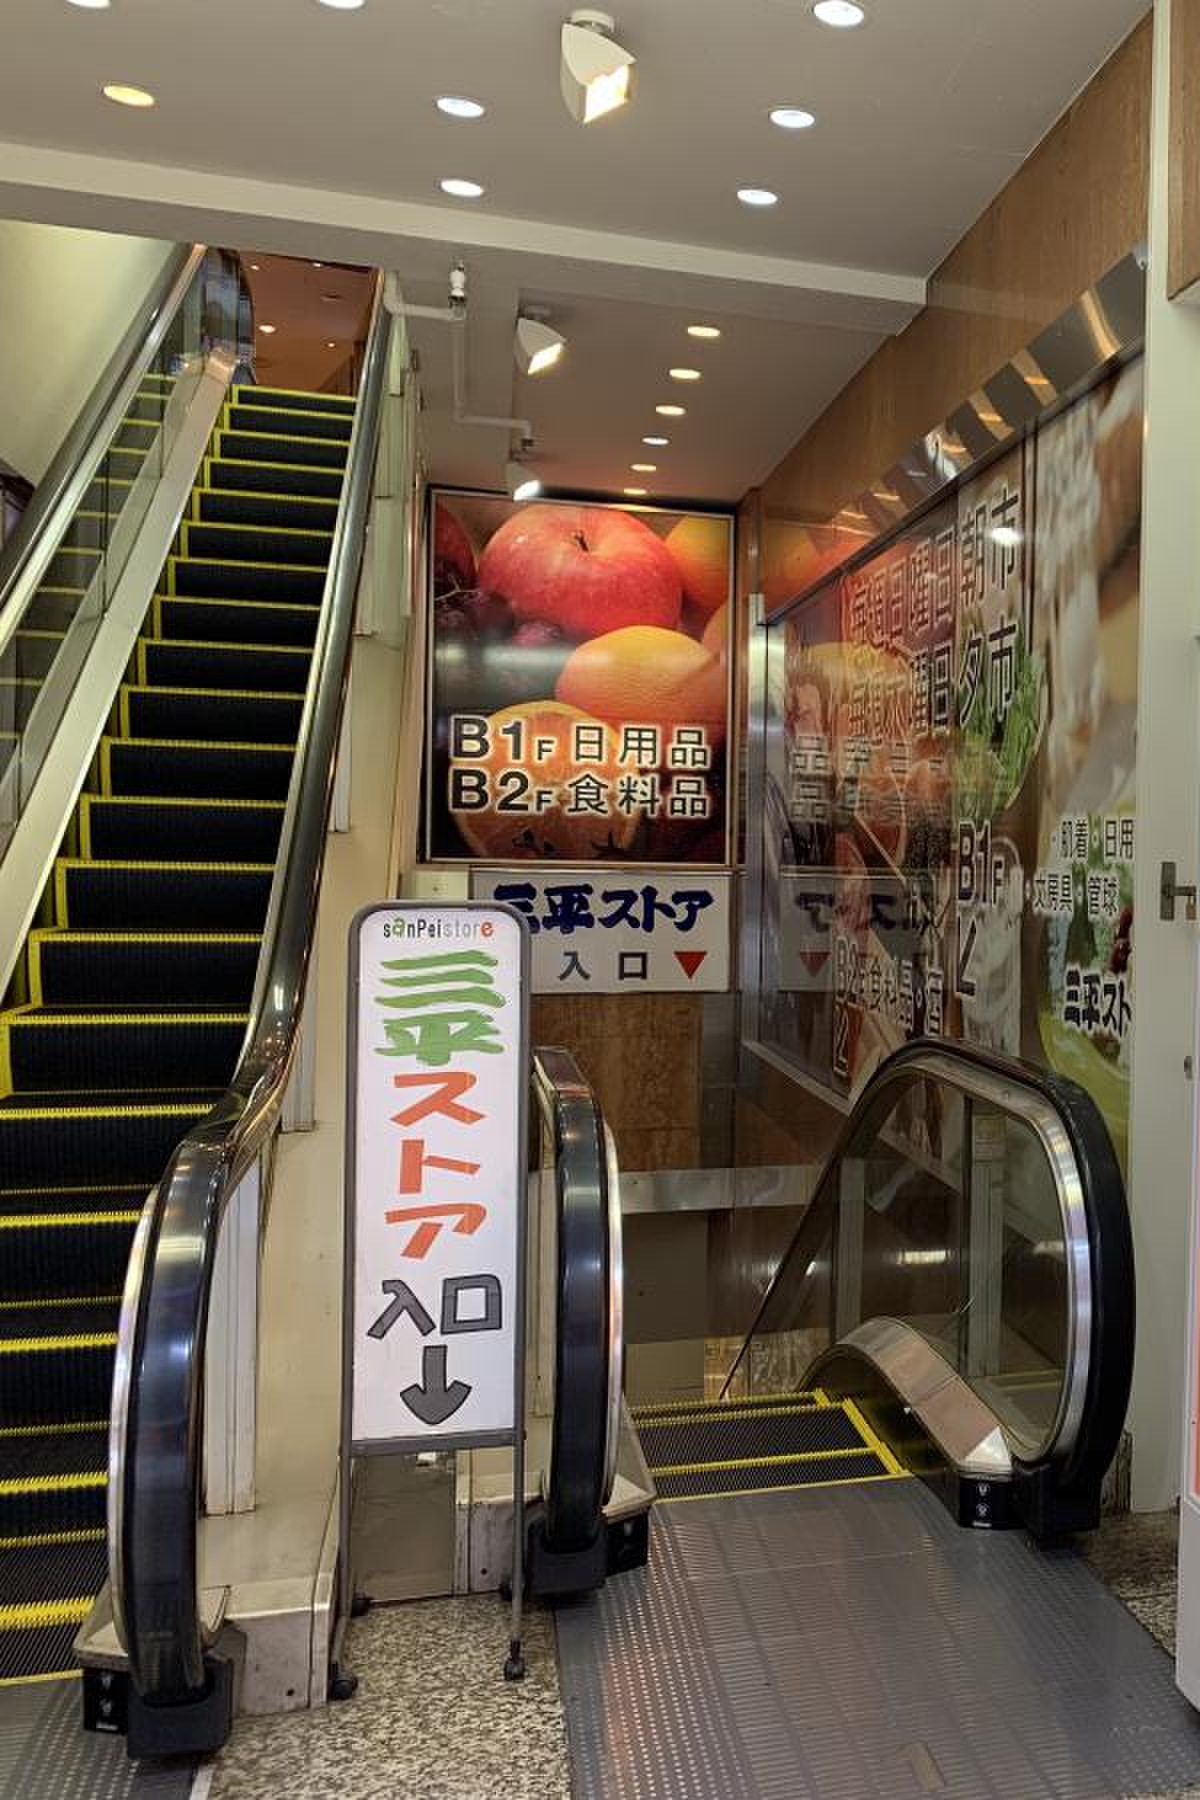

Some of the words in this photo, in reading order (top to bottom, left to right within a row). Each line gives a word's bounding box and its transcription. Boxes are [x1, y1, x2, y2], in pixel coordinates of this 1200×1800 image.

[452, 716, 555, 762] B1F
[574, 725, 708, 767] 日用品
[451, 769, 554, 812] B2F
[568, 773, 707, 817] 食料品
[959, 820, 1003, 905] B1F
[557, 951, 648, 981] 入口
[365, 1272, 504, 1340] 入口
